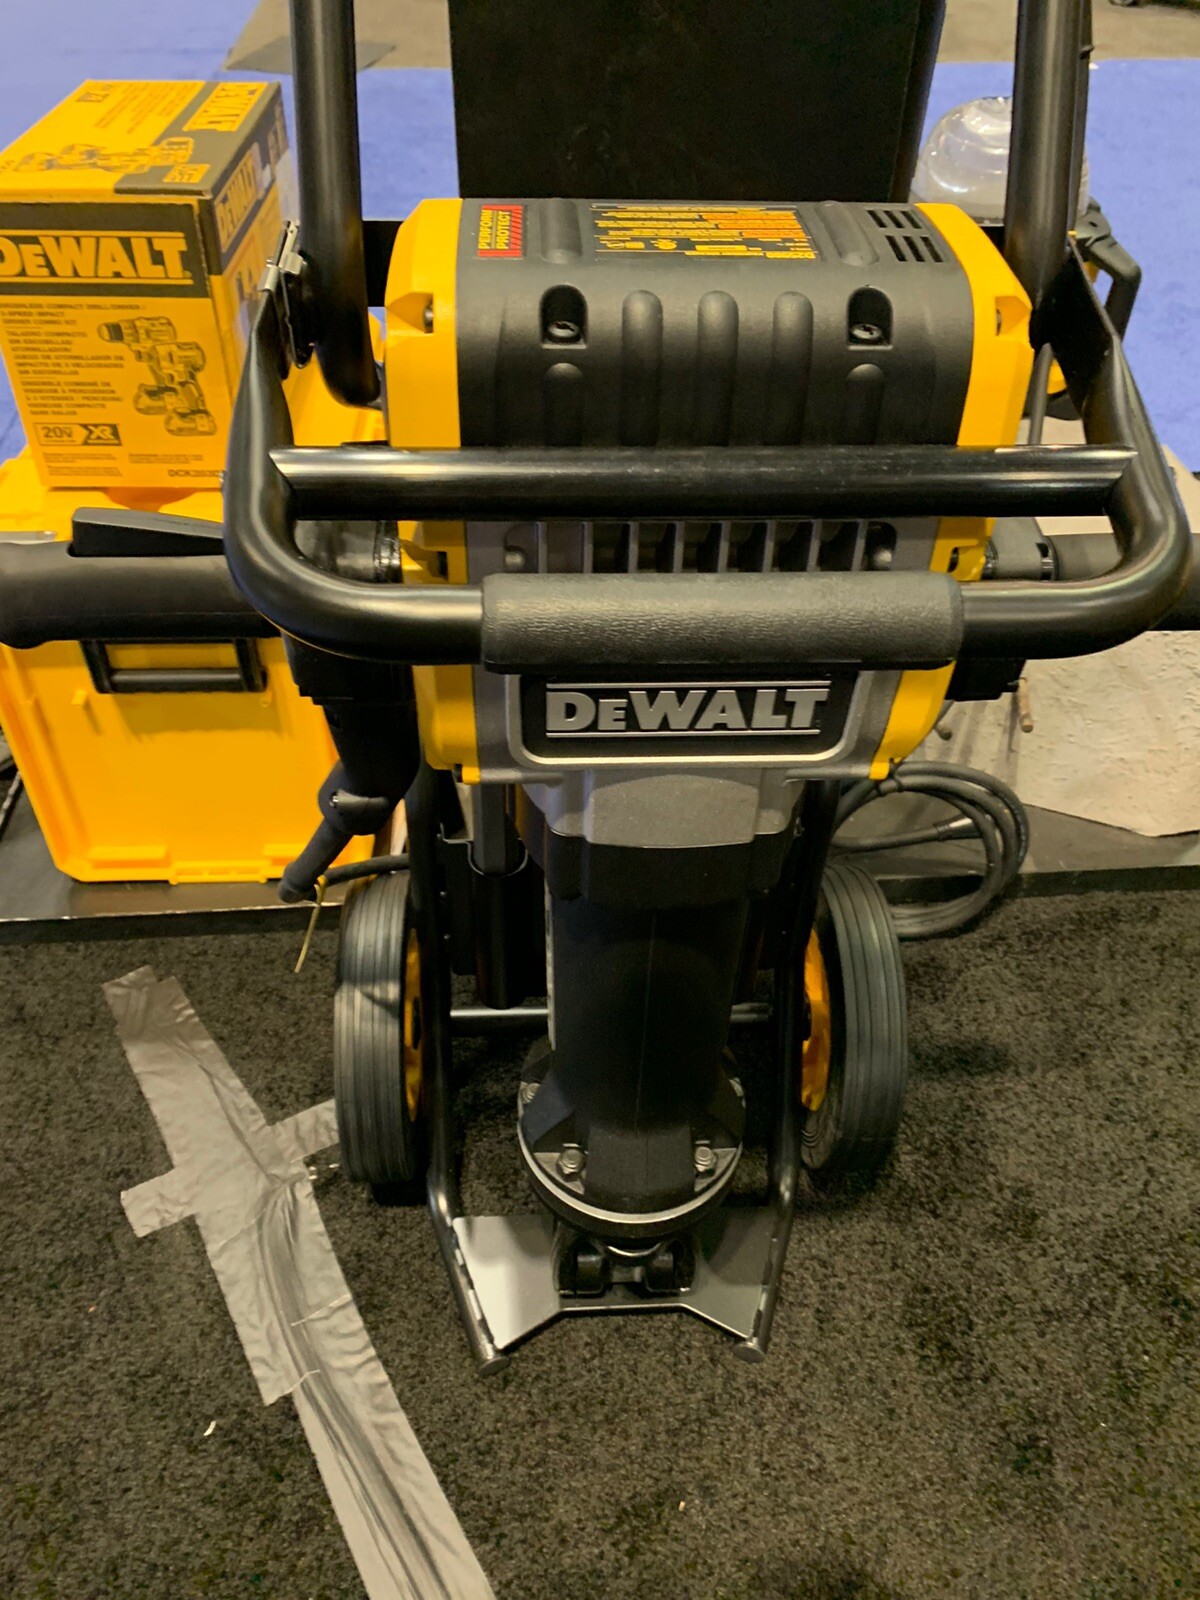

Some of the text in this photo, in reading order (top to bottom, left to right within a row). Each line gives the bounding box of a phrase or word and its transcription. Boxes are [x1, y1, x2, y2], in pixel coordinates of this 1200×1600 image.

[478, 209, 493, 249] PERFORM
[496, 210, 511, 250] PROTECT
[546, 689, 829, 731] DEWALT
